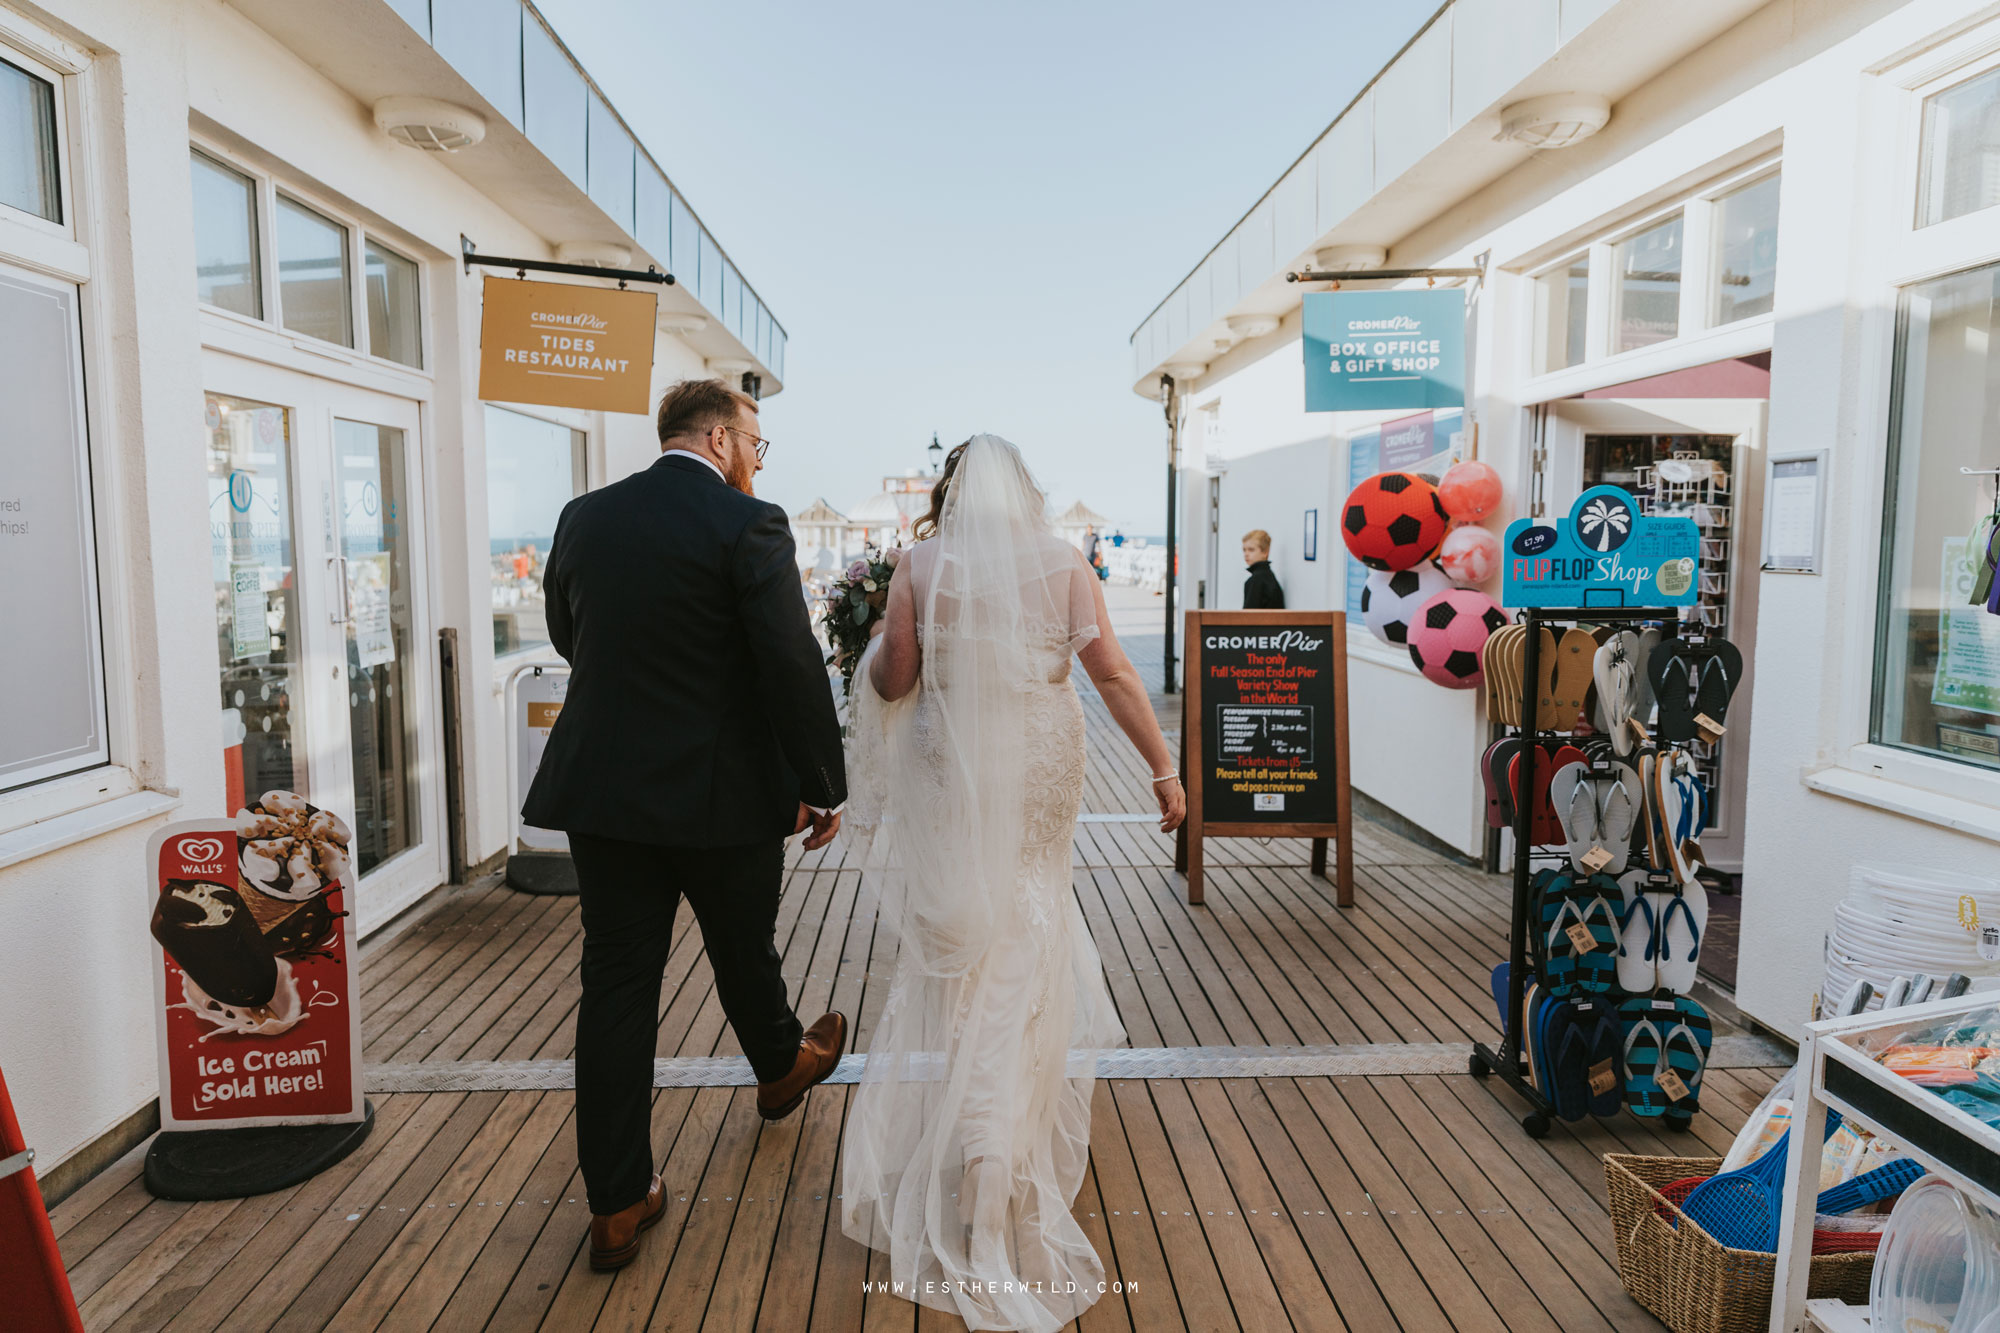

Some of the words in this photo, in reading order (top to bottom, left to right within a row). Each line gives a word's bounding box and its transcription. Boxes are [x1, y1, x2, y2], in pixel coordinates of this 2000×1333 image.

[531, 312, 580, 325] CROMER
[579, 313, 608, 329] Pier
[1348, 319, 1393, 330] CROMER
[1392, 316, 1421, 330] Pier
[541, 335, 595, 352] TIDES
[1330, 343, 1367, 356] BOX
[1373, 340, 1440, 355] OFFICE
[505, 349, 629, 373] RESTAURANT
[1330, 360, 1341, 373] &
[1346, 359, 1386, 372] GIFT
[1392, 357, 1440, 371] SHOP
[1524, 534, 1545, 547] £7.99
[1594, 552, 1653, 595] Shop
[236, 580, 260, 592] COFFEE
[1206, 636, 1280, 649] CROMER
[1279, 630, 1323, 652] Pier
[1246, 653, 1264, 665] The
[1265, 653, 1287, 667] only
[1211, 666, 1228, 678] Full
[1230, 666, 1265, 678] Season
[1266, 666, 1285, 678] End
[1286, 666, 1296, 678] of
[1297, 666, 1318, 678] Pier
[1237, 679, 1271, 692] Variety
[1273, 679, 1299, 691] Show
[1240, 693, 1250, 704] in
[1251, 693, 1266, 704] the
[1266, 693, 1298, 704] World
[1237, 755, 1265, 767] Tickets
[1266, 756, 1288, 767] from
[1216, 768, 1242, 779] Please
[1243, 768, 1256, 779] tell
[1257, 768, 1268, 779] all
[1269, 770, 1288, 781] your
[1289, 768, 1318, 780] friends
[1232, 781, 1248, 792] and
[1249, 783, 1263, 793] pop
[1262, 783, 1268, 792] a
[1269, 781, 1295, 792] review
[1295, 784, 1305, 792] on
[181, 864, 223, 874] WALL'S
[198, 1055, 235, 1076] Ice
[243, 1047, 321, 1072] Cream
[201, 1076, 257, 1102] Sold
[264, 1069, 323, 1096] Here!
